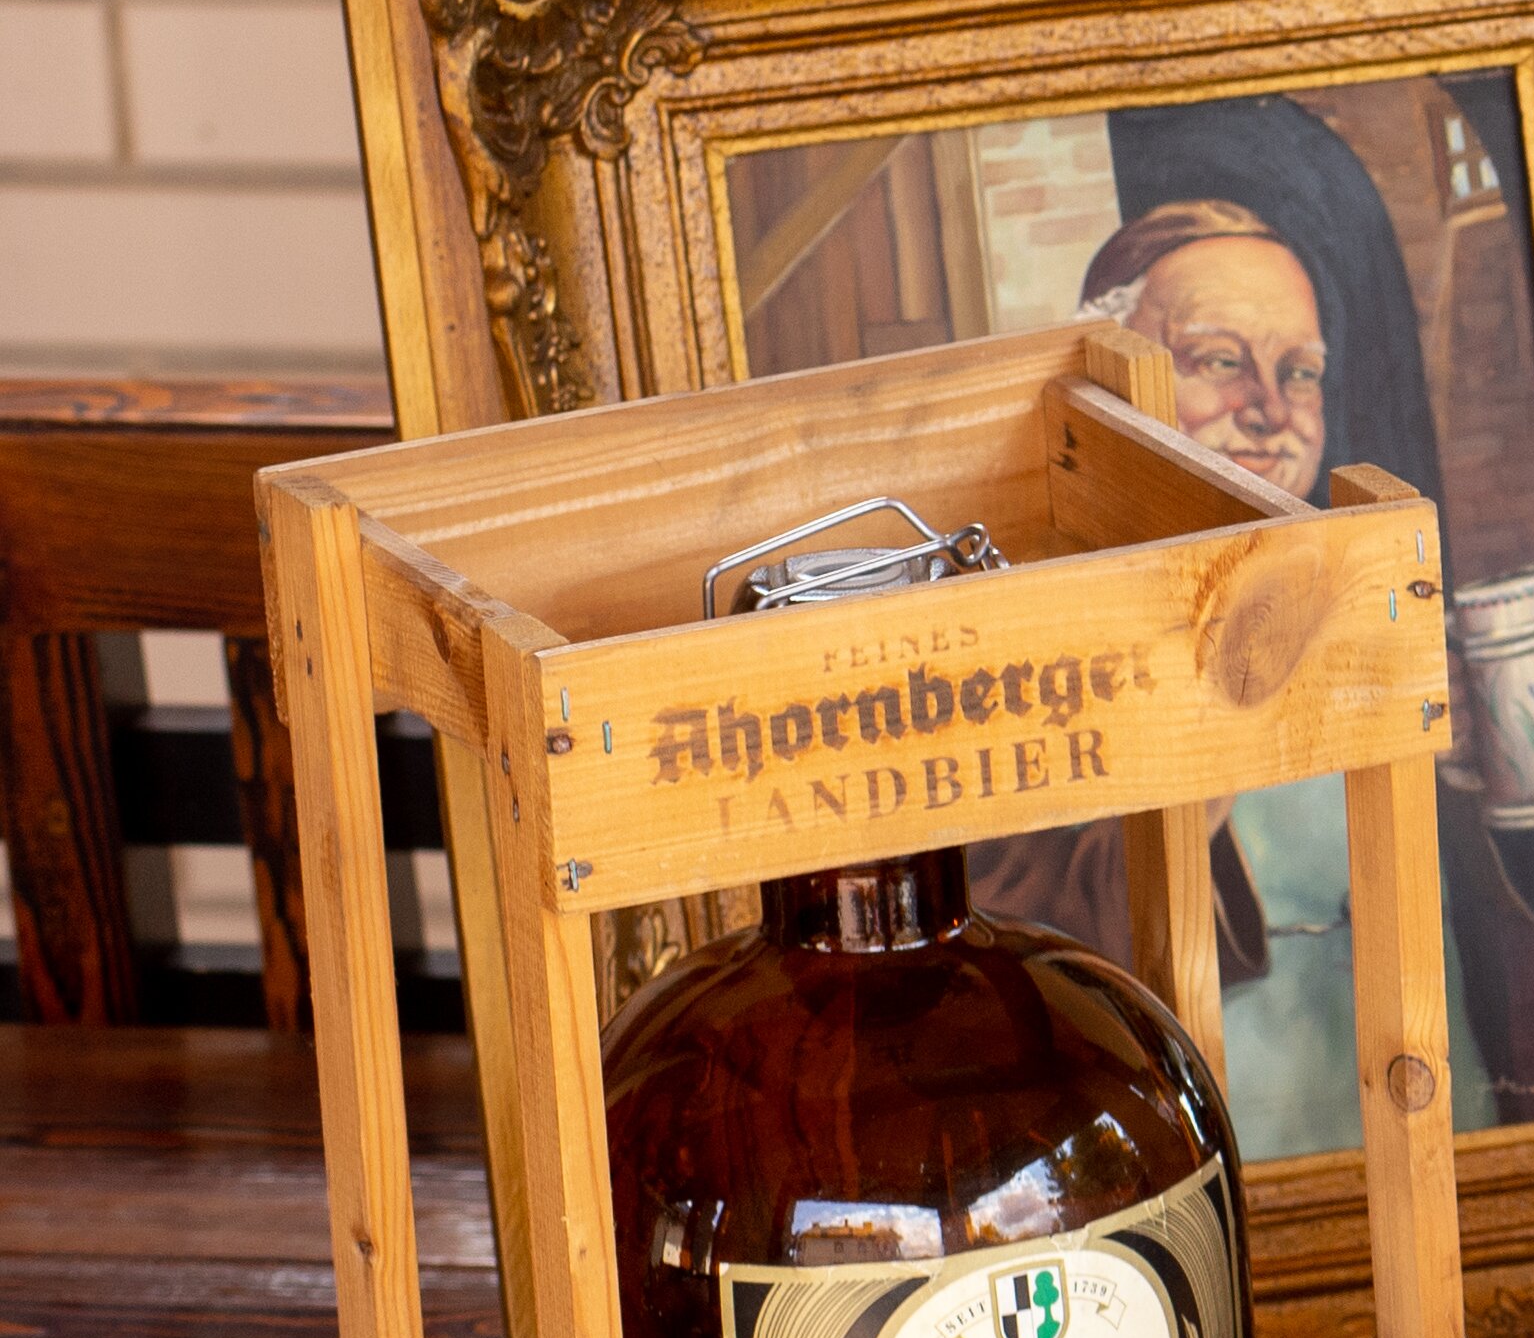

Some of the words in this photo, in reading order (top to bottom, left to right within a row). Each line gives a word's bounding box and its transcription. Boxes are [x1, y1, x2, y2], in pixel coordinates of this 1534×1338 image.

[821, 624, 980, 673] FEINES
[647, 643, 1160, 787] Ahornberger
[714, 728, 1111, 843] LANDBIER
[945, 1300, 987, 1335] SEIT
[1073, 1279, 1108, 1297] 1739
